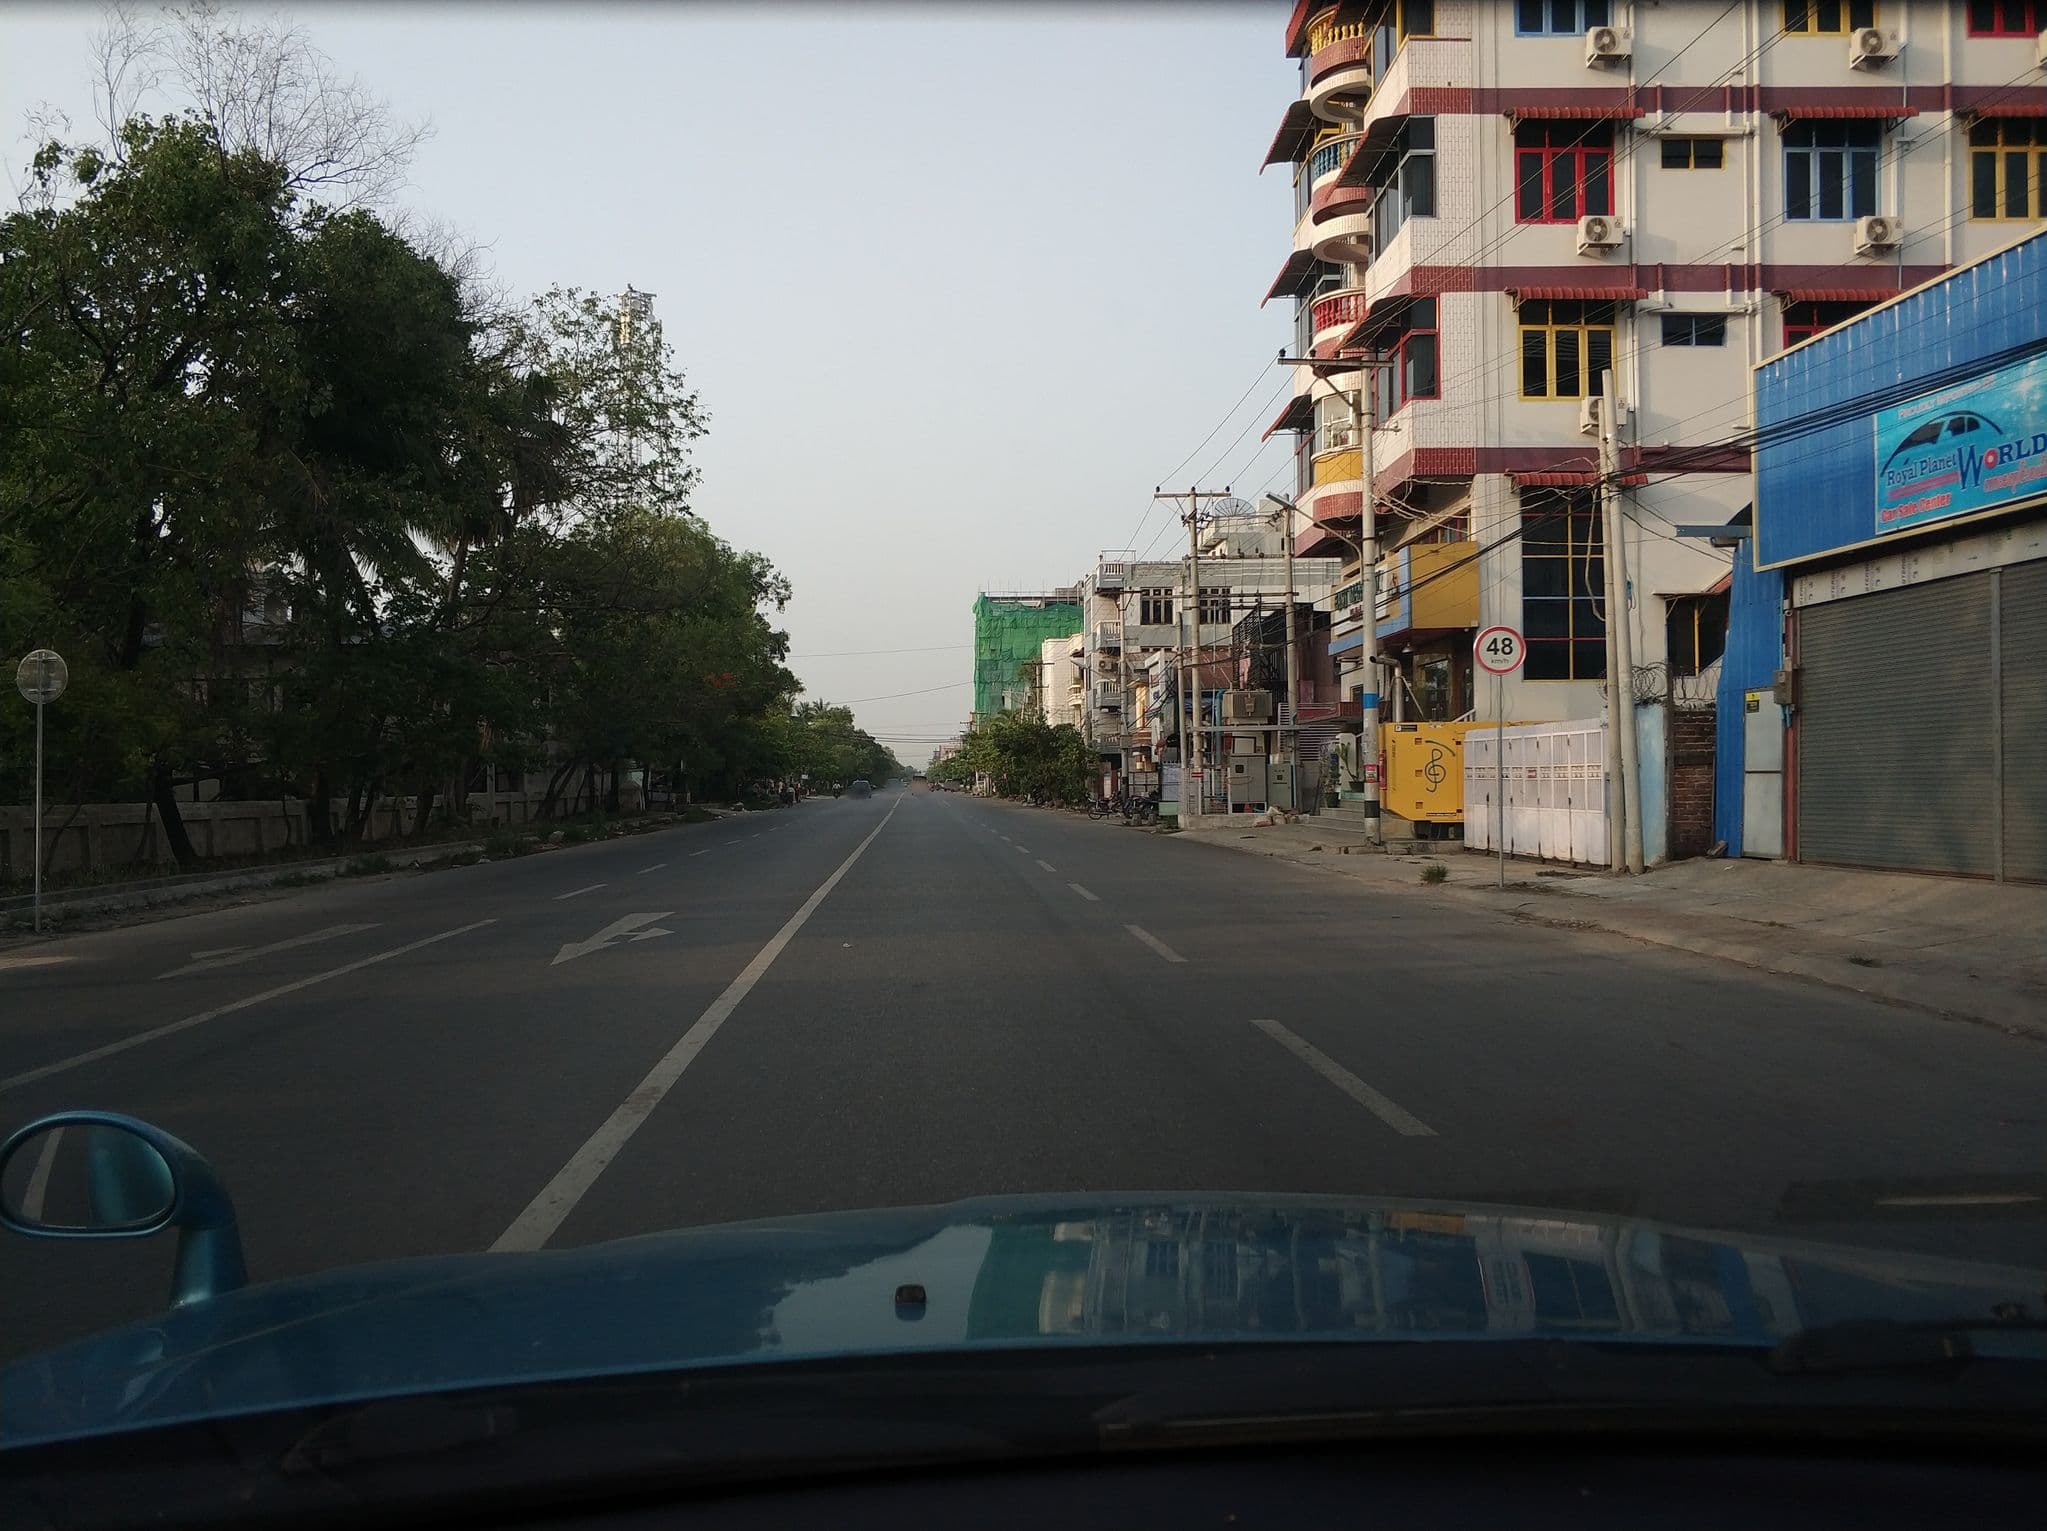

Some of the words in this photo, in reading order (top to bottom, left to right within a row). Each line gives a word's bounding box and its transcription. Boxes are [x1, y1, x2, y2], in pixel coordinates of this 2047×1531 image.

[1887, 461, 1917, 486] Royal
[1920, 454, 1956, 477] Planet
[1486, 637, 1513, 655] 48
